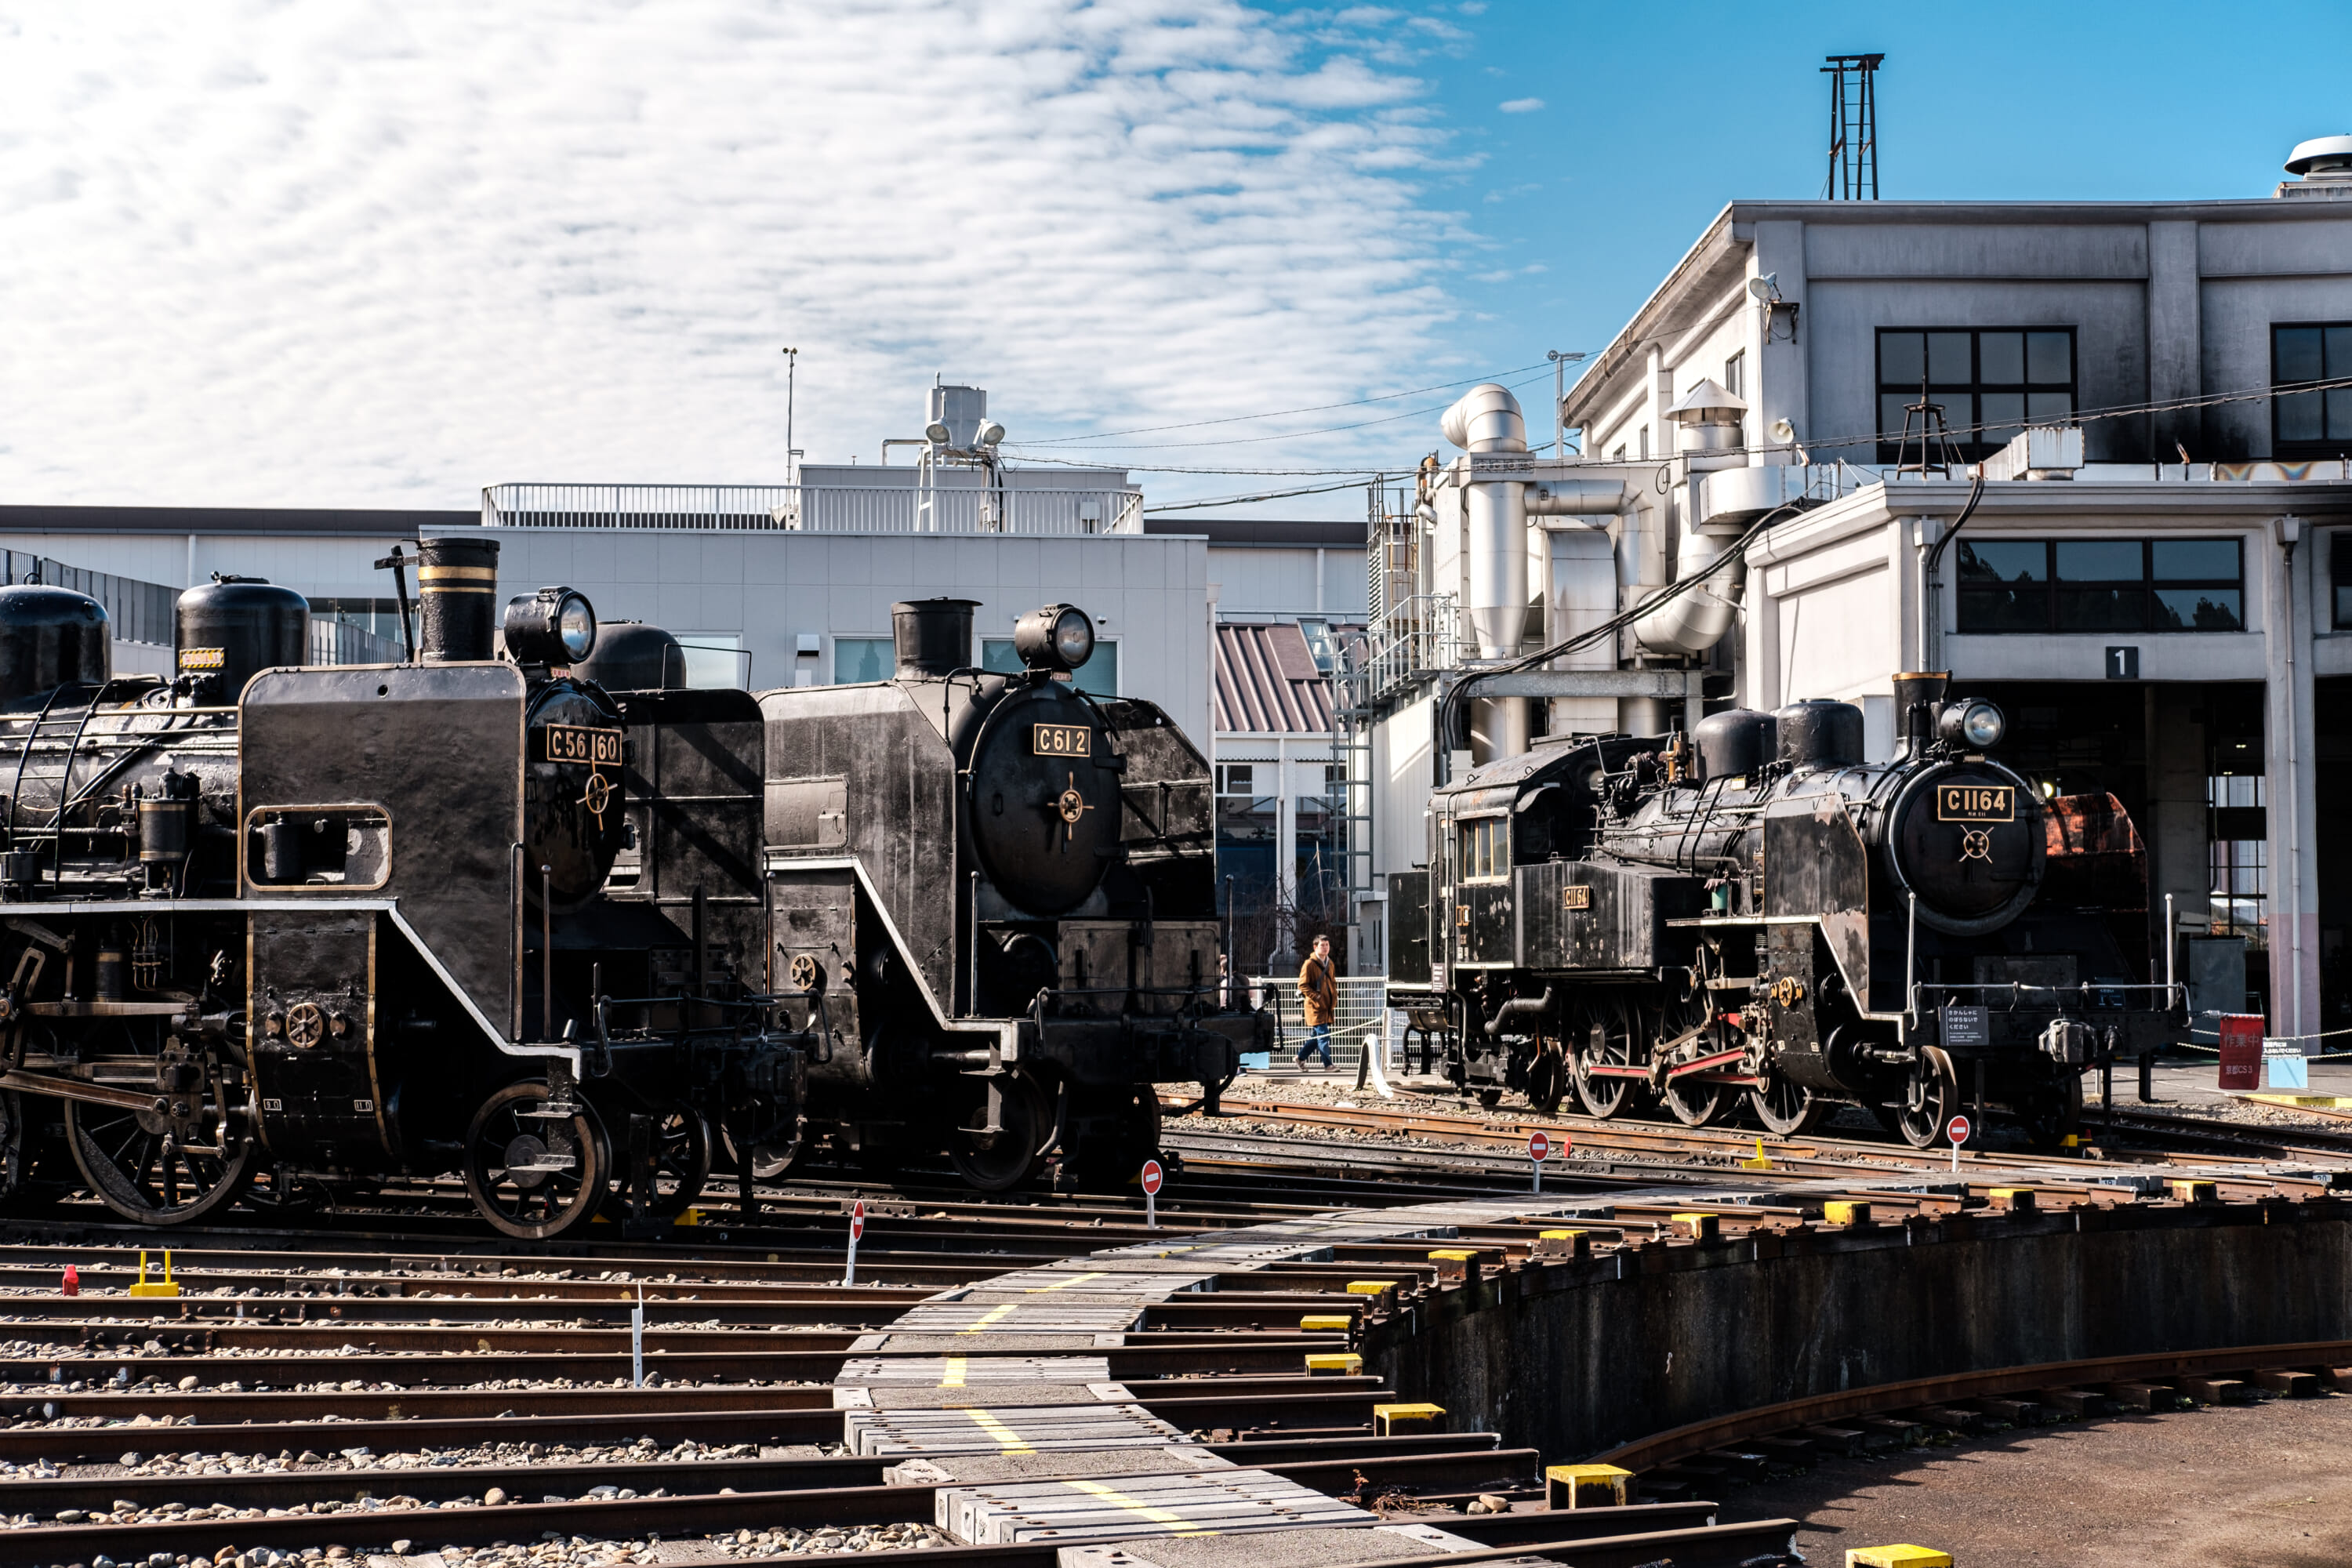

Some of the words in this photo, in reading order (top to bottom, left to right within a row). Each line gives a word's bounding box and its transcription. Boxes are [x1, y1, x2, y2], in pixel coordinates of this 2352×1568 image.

[2114, 649, 2125, 676] 1
[2224, 1031, 2259, 1048] 作業中
